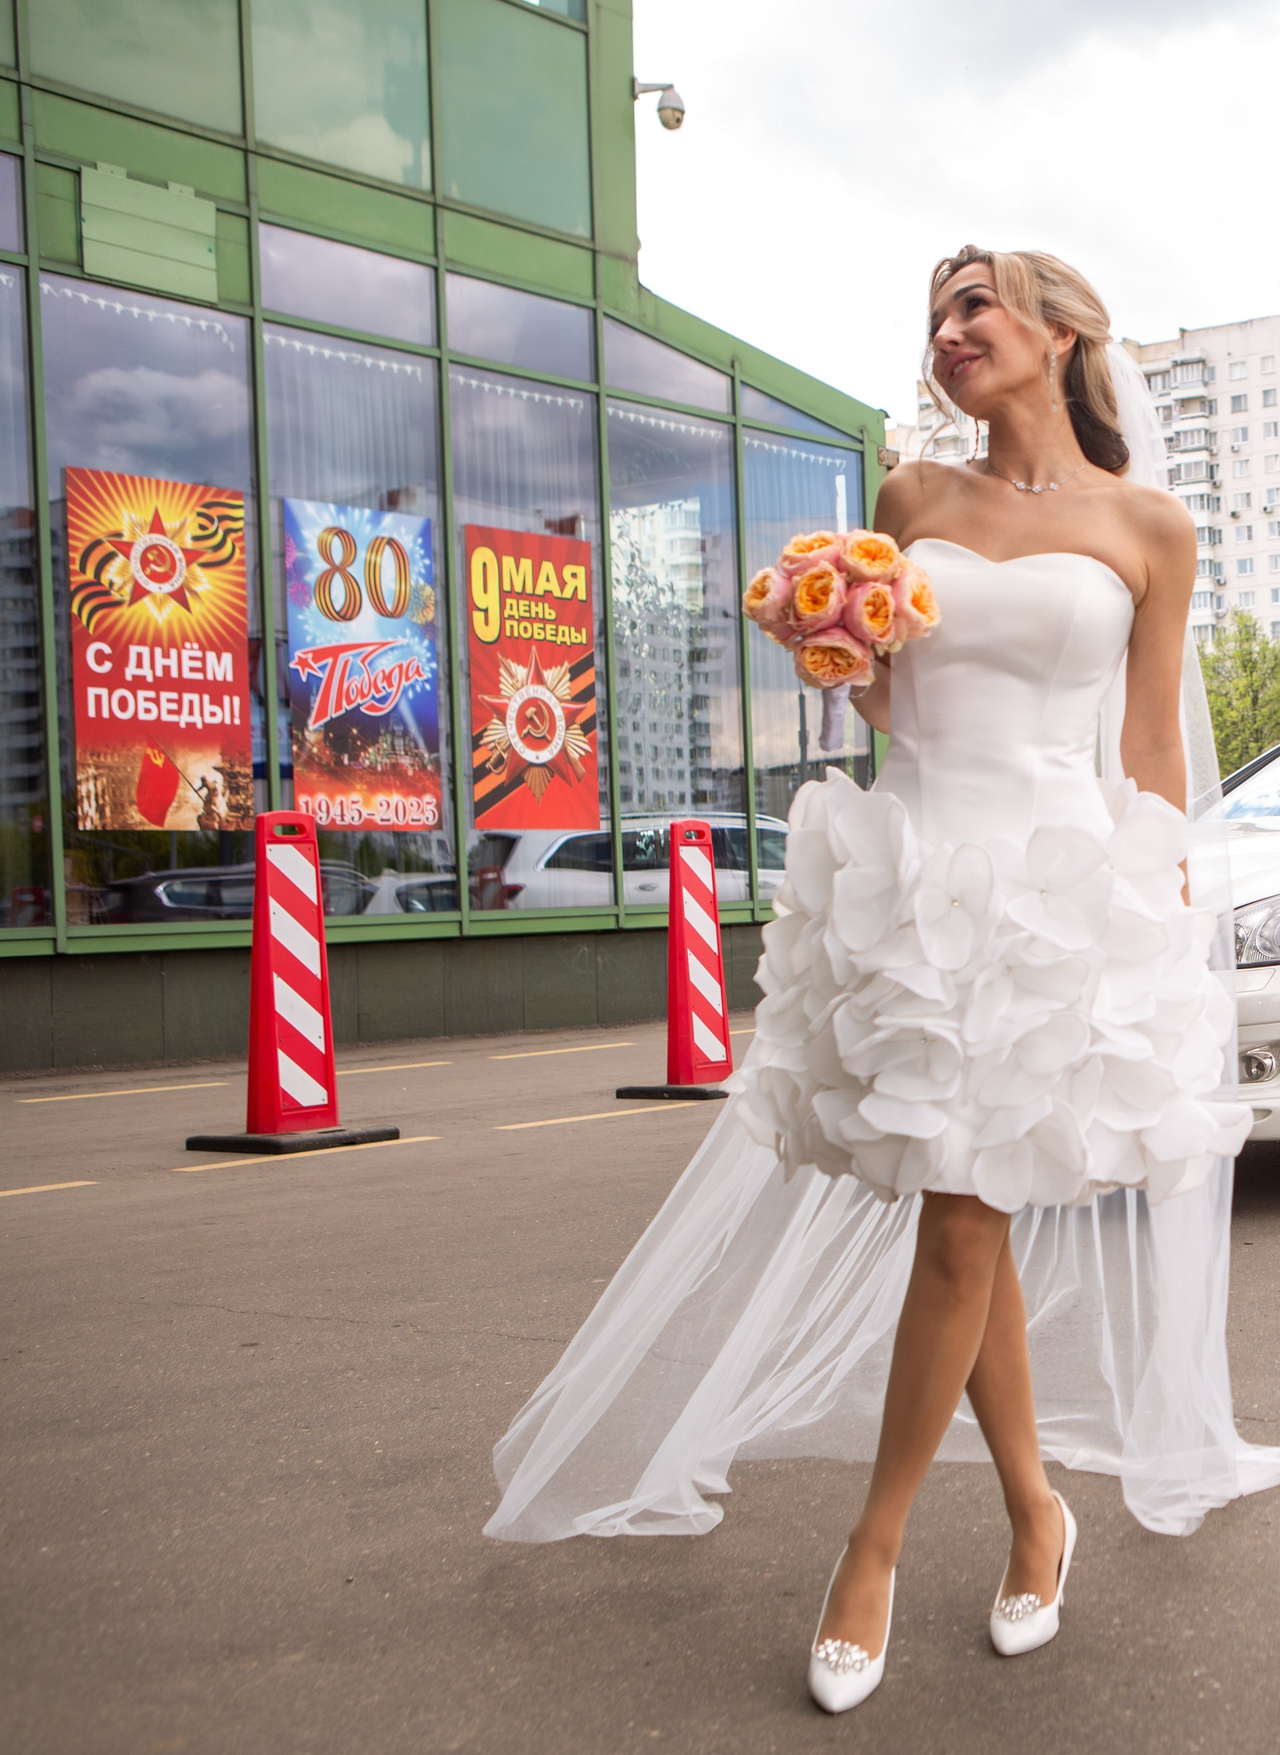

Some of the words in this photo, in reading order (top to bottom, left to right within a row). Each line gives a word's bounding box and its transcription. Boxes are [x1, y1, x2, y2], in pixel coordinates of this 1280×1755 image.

[314, 526, 411, 622] 80
[470, 546, 501, 644] 9
[502, 555, 587, 602] МАЯ
[503, 598, 557, 621] ДЕНЬ
[504, 619, 588, 647] ПОБЕДЫ
[86, 641, 113, 674] С
[125, 642, 234, 683] ДНЁМ
[295, 639, 427, 729] Победа
[87, 686, 241, 729] ПОБЕДЫ!
[299, 796, 439, 825] 1945-2025
